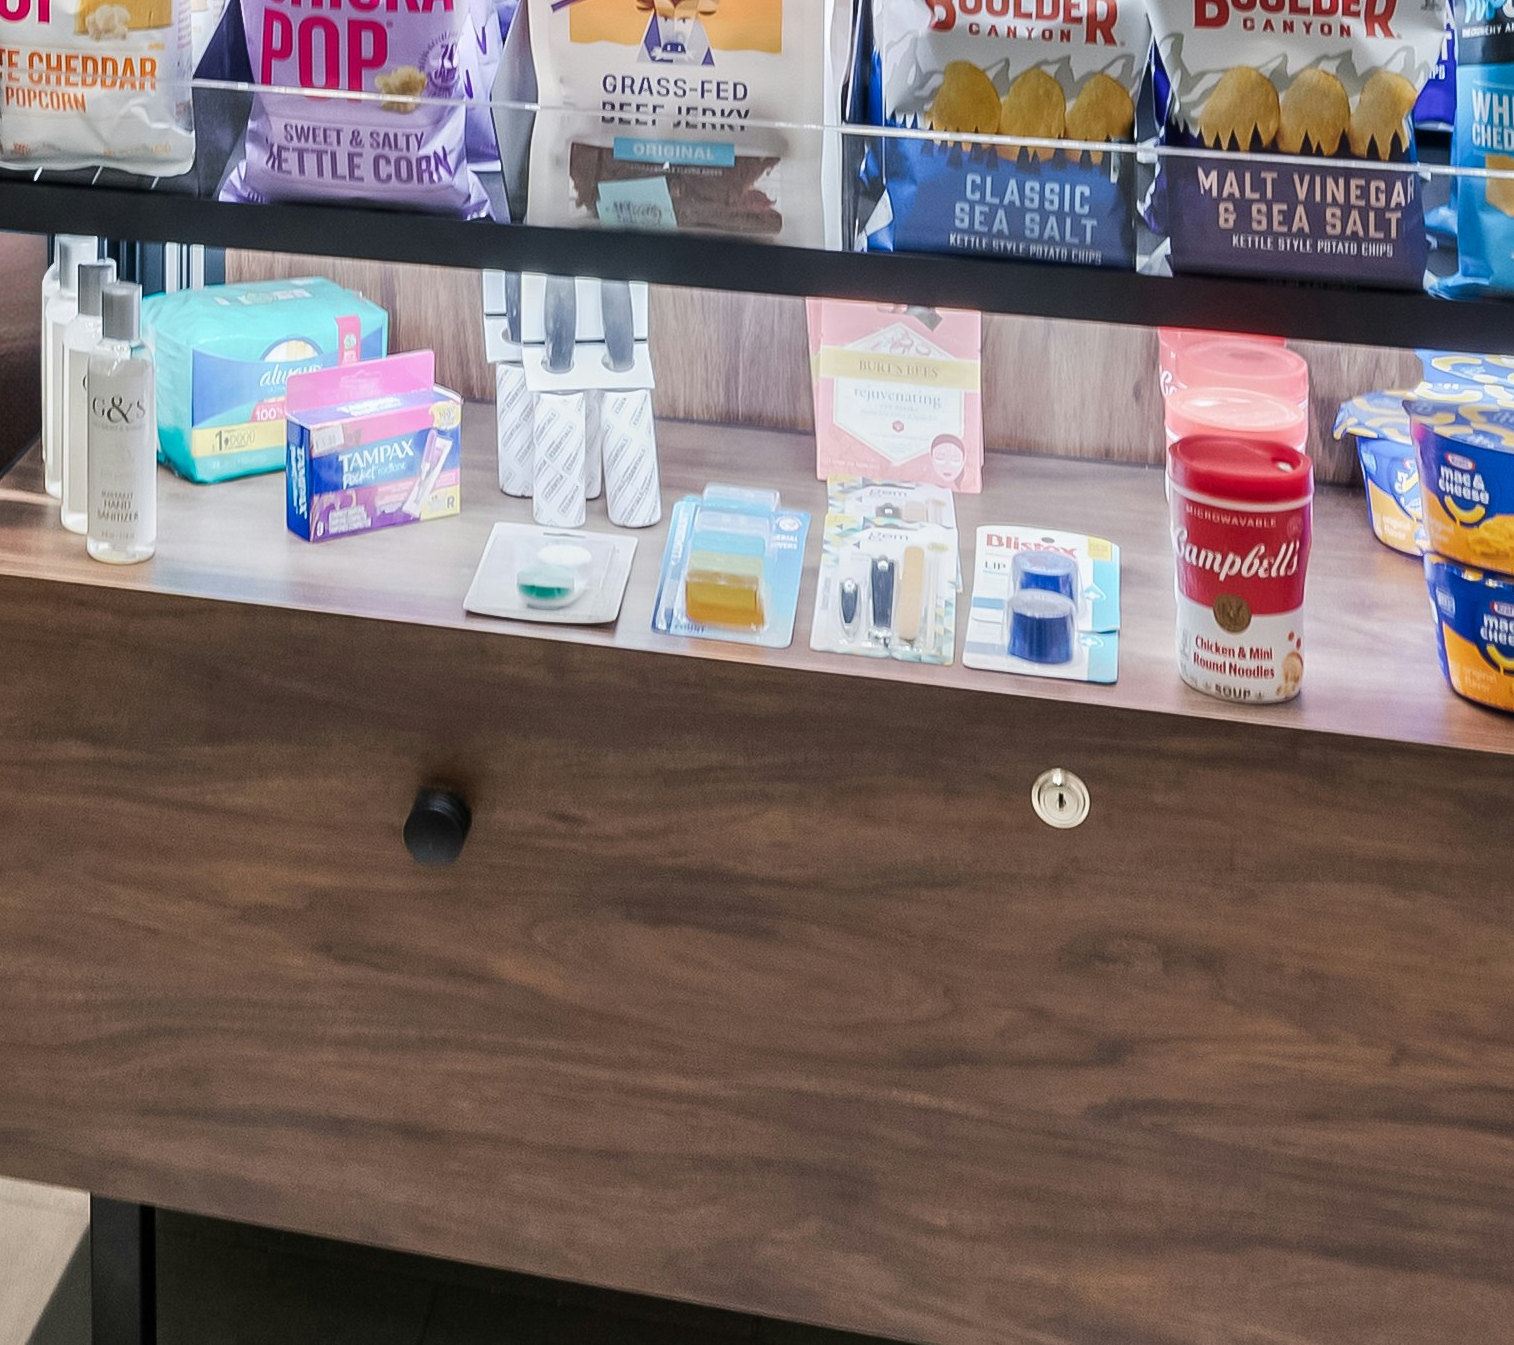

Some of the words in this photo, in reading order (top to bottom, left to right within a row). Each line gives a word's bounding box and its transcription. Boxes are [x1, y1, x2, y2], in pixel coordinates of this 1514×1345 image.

[968, 22, 1072, 44] CANYON
[1242, 18, 1351, 39] CANYON
[261, 8, 388, 104] POP
[27, 53, 158, 91] CHEDDAR
[5, 89, 87, 114] POPCORN
[601, 73, 749, 103] GRASS-FED
[601, 102, 664, 126] BEEF
[676, 106, 751, 132] JERKY
[284, 123, 342, 146] SWEET
[348, 127, 364, 146] &
[368, 129, 425, 150] SALTY
[266, 142, 365, 184] KETTLE
[373, 145, 454, 186] CORN
[632, 143, 714, 162] ORIGINAL
[965, 172, 1091, 215] CLASSIC
[1197, 167, 1278, 201] MALT
[1293, 172, 1417, 207] VINEGAR
[954, 203, 1016, 233] SEA
[1025, 211, 1097, 246] SALT
[1218, 204, 1236, 228] &
[1251, 204, 1311, 233] SEA
[1325, 210, 1402, 240] SALT
[1232, 235, 1273, 251] KETTLE
[1277, 237, 1313, 253] STYLE
[1316, 240, 1357, 256] POTATO
[1361, 242, 1394, 258] CHIPS
[859, 360, 900, 377] BURT'S
[905, 363, 940, 378] BEES
[92, 396, 147, 424] G&S
[853, 385, 942, 409] rejuvenating
[339, 438, 415, 473] TAMPAX
[1186, 505, 1277, 529] MICROWAVABLE
[1173, 527, 1299, 582] Campbell's
[1195, 638, 1233, 660] Chicken
[1237, 645, 1248, 658] &
[1251, 646, 1273, 660] Mini
[1194, 653, 1225, 675] Round
[1228, 662, 1275, 680] Noodles
